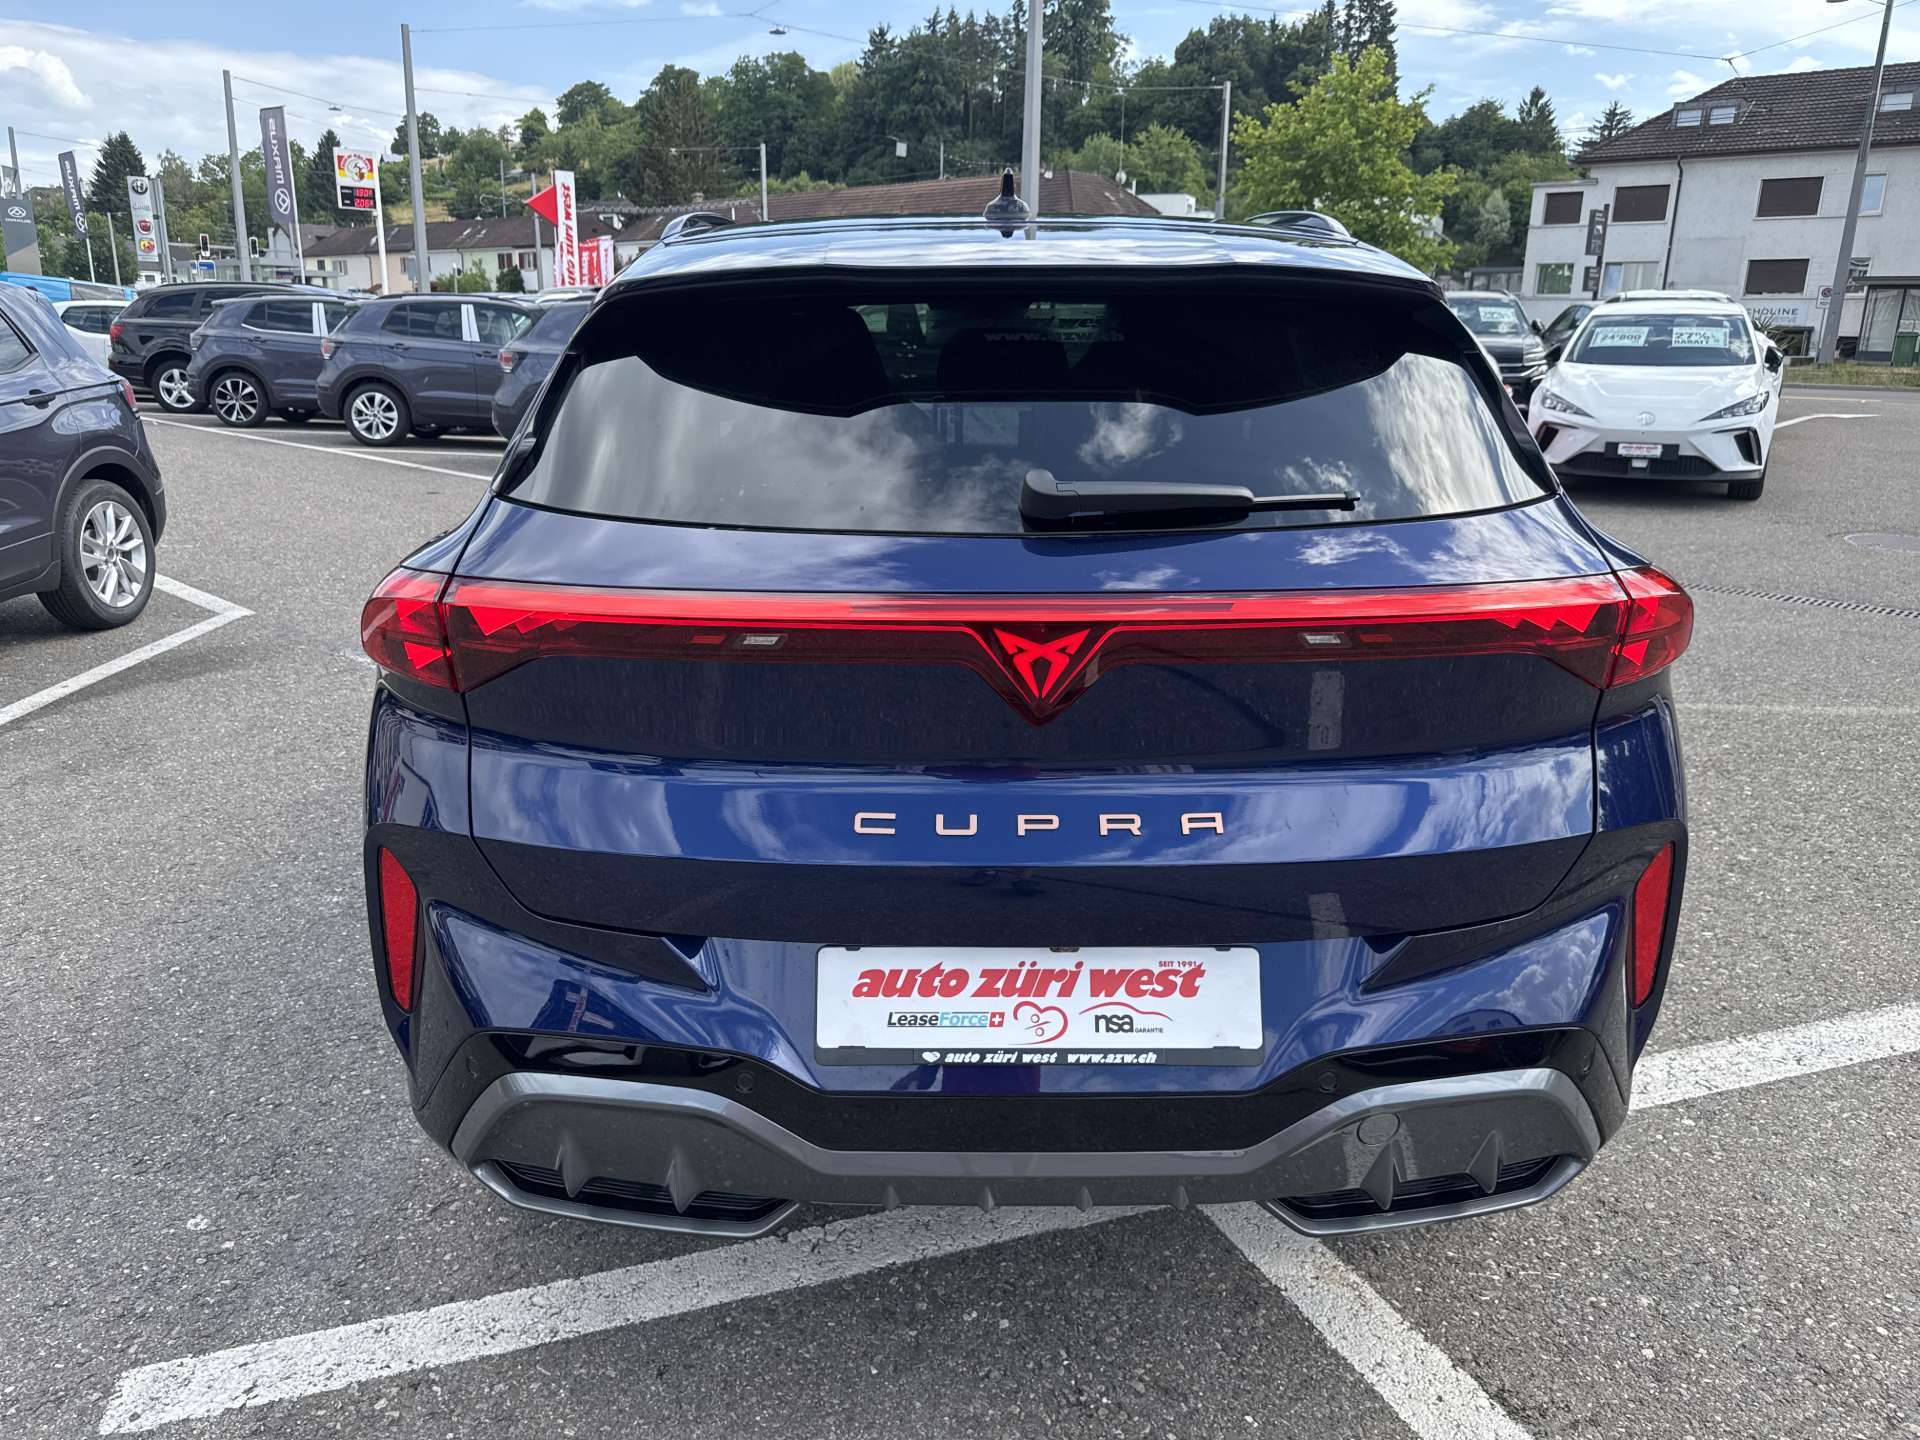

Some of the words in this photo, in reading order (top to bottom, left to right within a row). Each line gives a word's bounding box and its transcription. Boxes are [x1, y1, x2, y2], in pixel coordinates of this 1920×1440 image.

[853, 811, 1225, 838] CUPRA
[852, 962, 970, 998] auto
[970, 961, 1084, 998] züri
[1089, 962, 1207, 998] west
[887, 1012, 989, 1027] LeaseForce
[1095, 1014, 1134, 1033] nsa
[945, 1052, 980, 1063] auto
[983, 1050, 1018, 1063] züri
[1022, 1052, 1058, 1063] west
[1067, 1052, 1157, 1064] www.azw.ch
